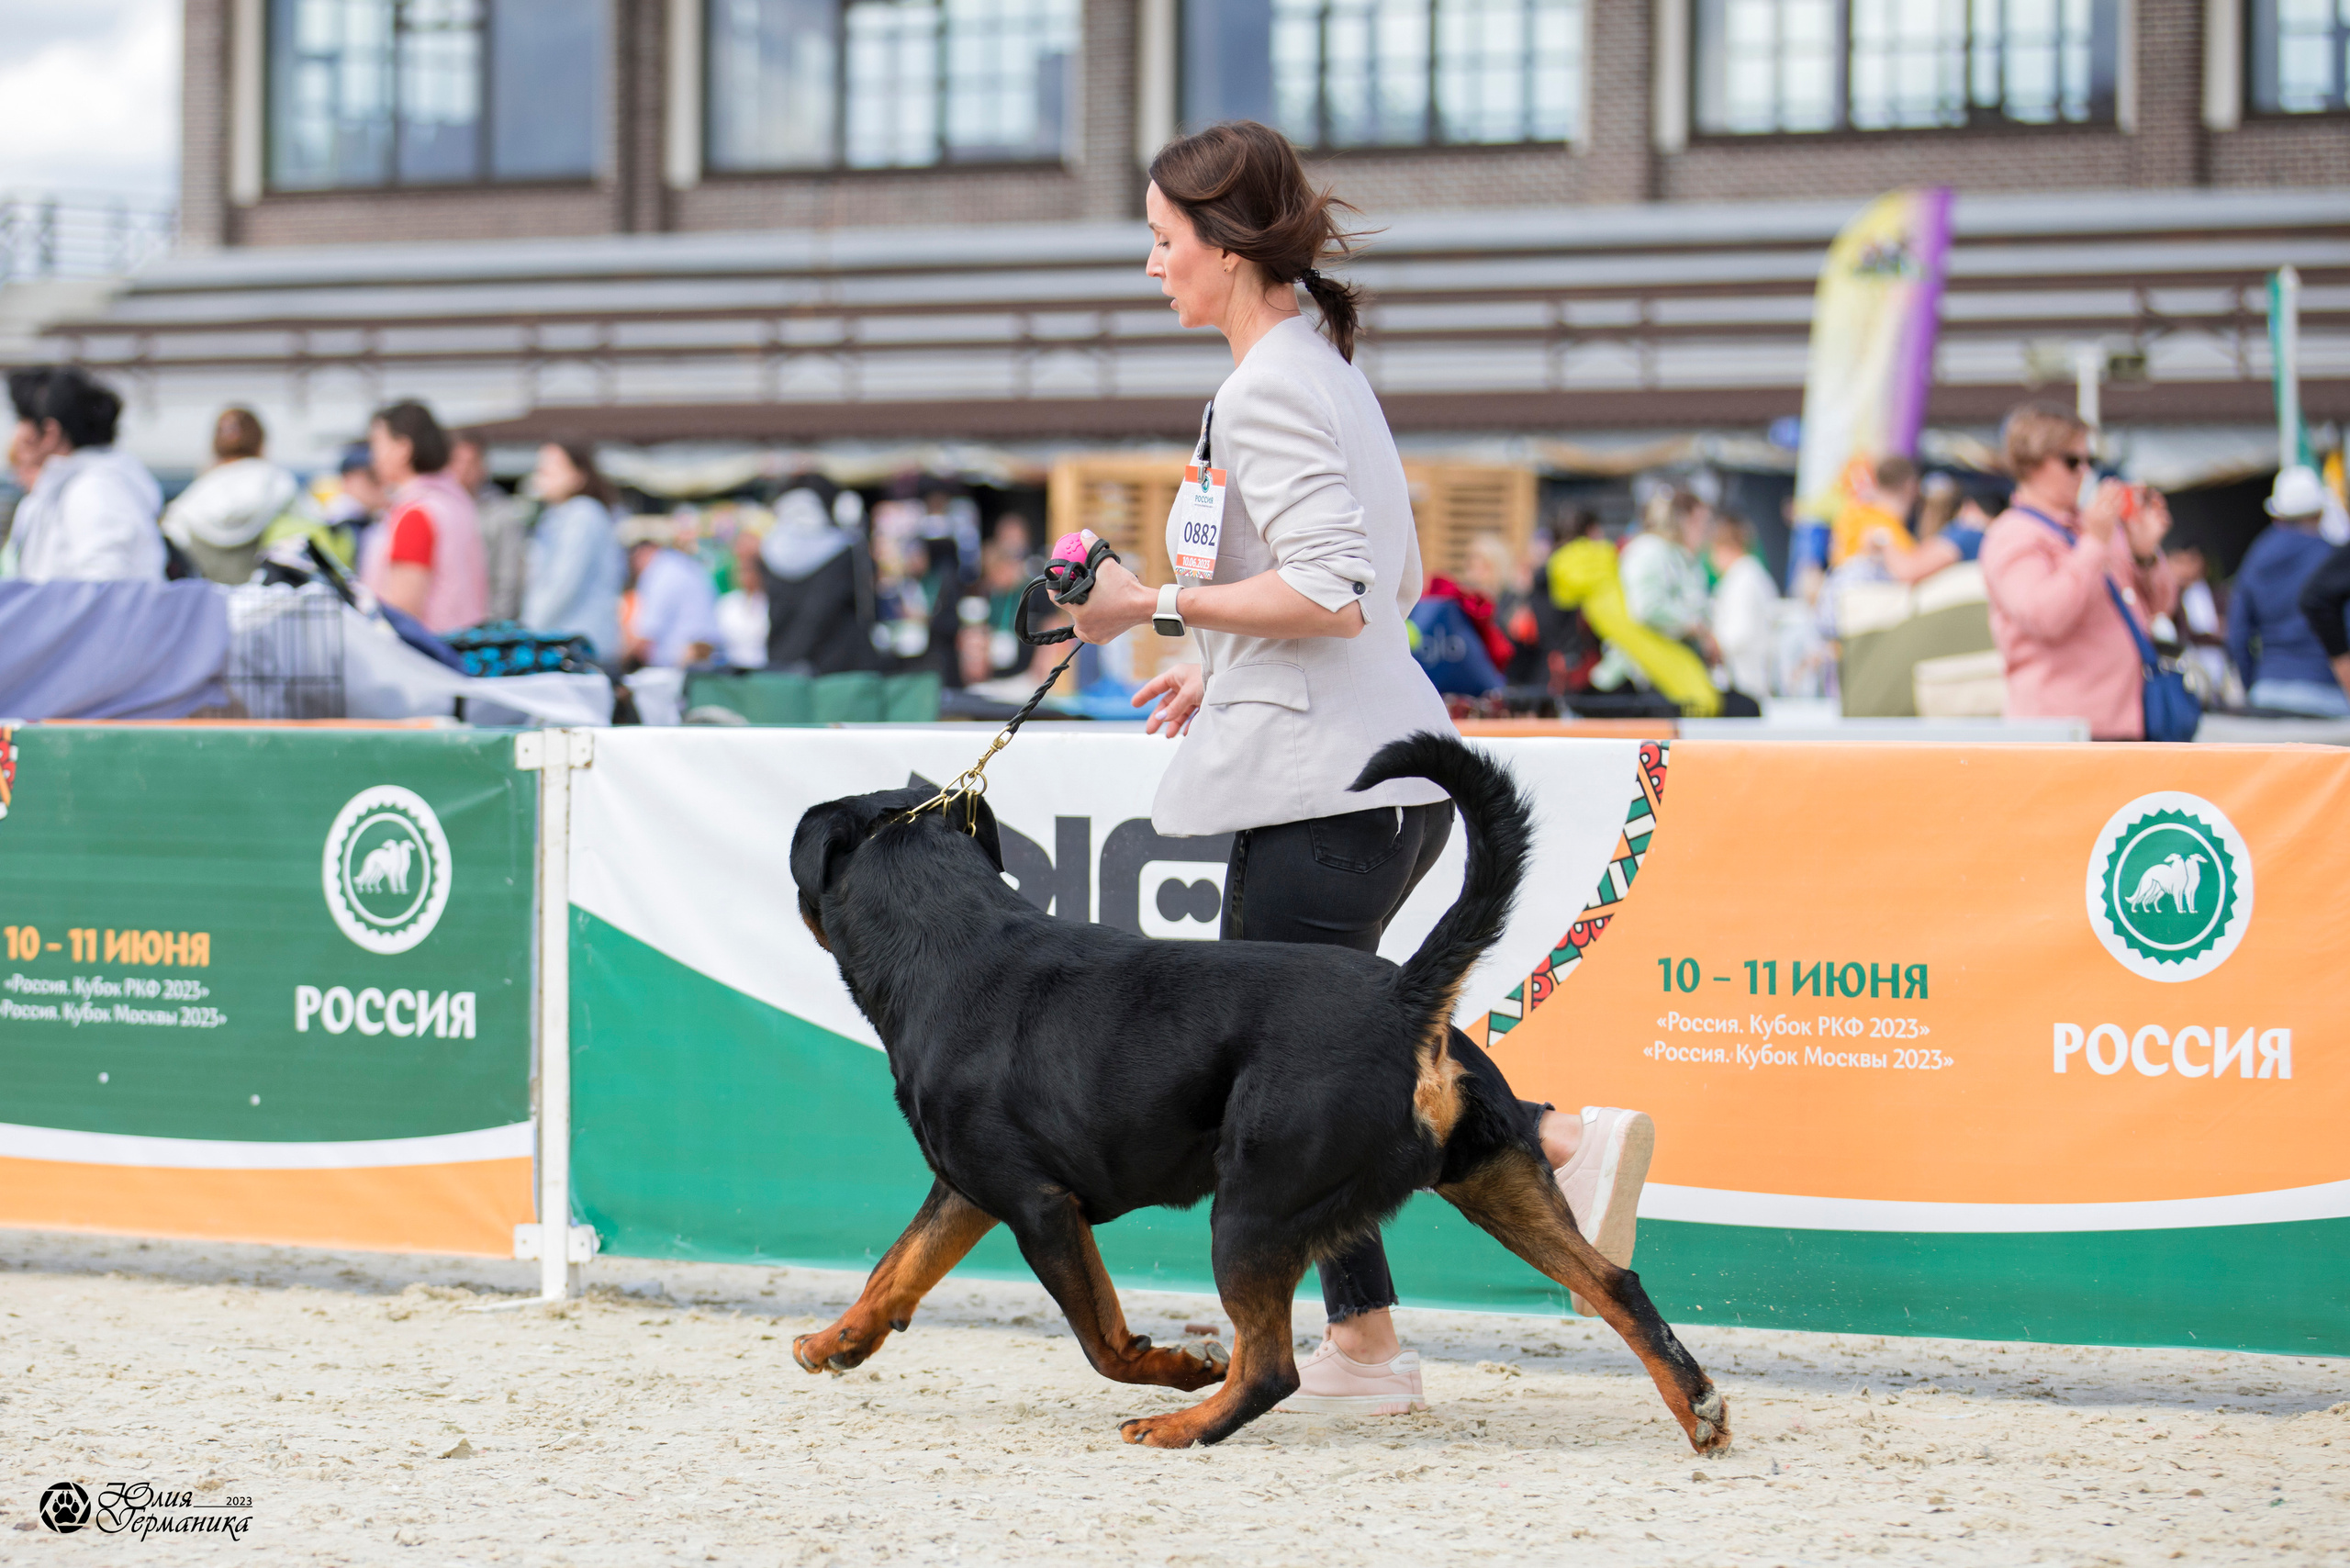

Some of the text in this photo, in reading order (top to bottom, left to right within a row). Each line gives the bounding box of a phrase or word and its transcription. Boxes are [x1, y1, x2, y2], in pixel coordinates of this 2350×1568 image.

[1194, 495, 1214, 505] РОССИЯ
[1184, 521, 1217, 546] 0882
[1182, 555, 1211, 570] 10.06.2023
[4, 925, 41, 961] 10
[67, 927, 98, 963] 11
[103, 928, 211, 968] ИЮНЯ
[3, 972, 211, 1002] «Россия. Кубок РКФ 2023»
[1657, 957, 1701, 993] 10
[1744, 959, 1777, 995] 11
[1792, 960, 1929, 1000] ИЮНЯ
[0, 998, 229, 1028] Россия. Кубок Москвы 2023»
[295, 984, 477, 1039] РОССИЯ
[1656, 1011, 1930, 1041] «Россия. Кубок РКФ 2023»
[1643, 1040, 1955, 1070] «Россия. Кубок Москвы 2023»
[2053, 1022, 2292, 1080] РОССИЯ
